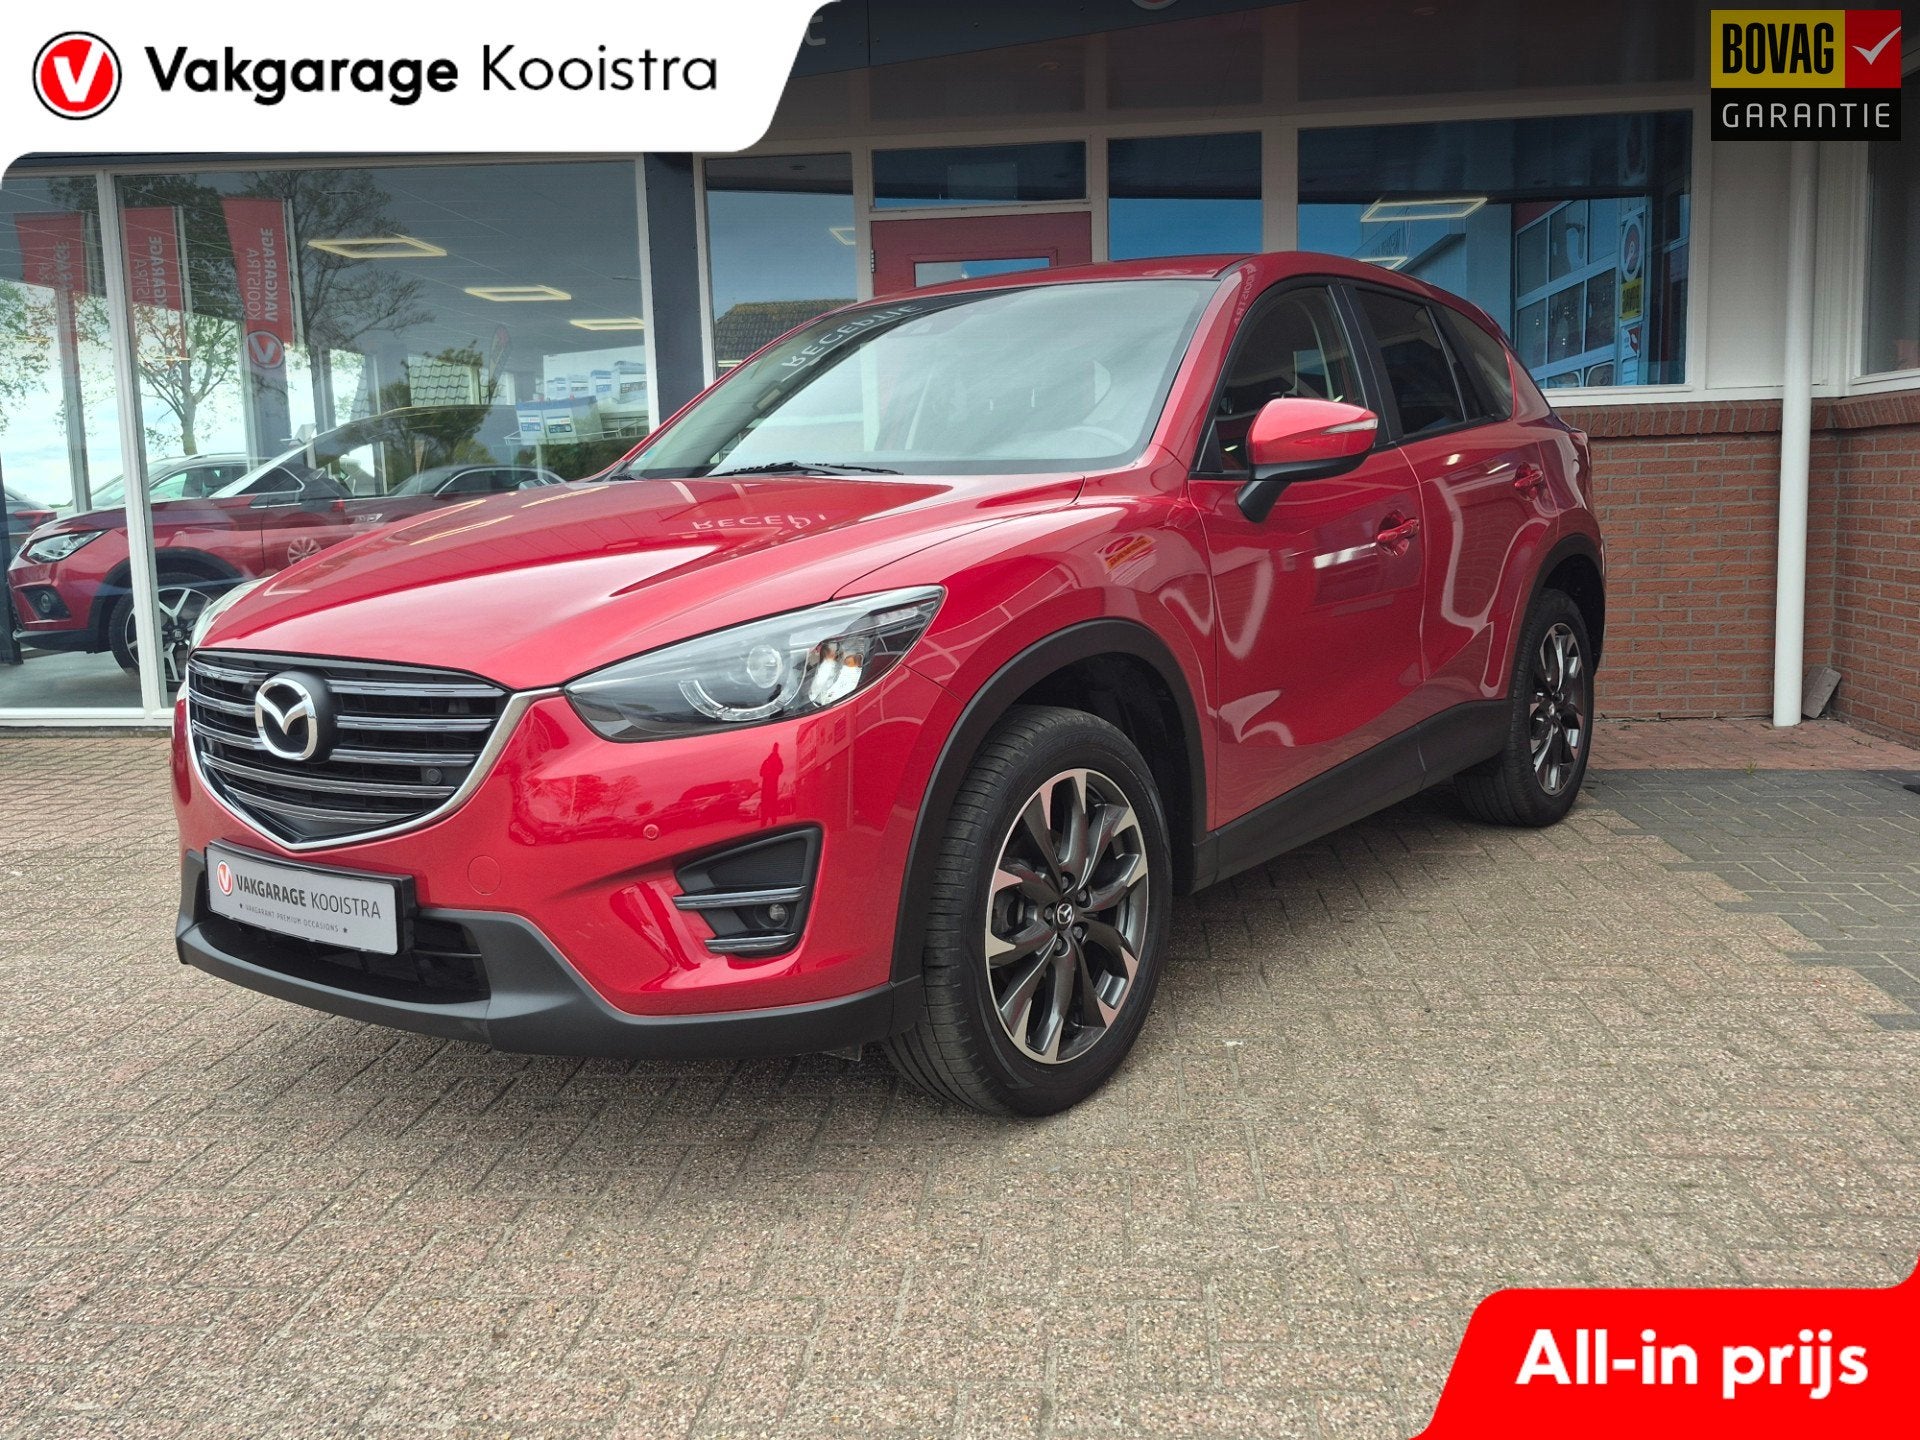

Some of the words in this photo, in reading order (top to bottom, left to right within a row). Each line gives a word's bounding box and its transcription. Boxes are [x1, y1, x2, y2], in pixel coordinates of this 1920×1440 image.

[236, 874, 307, 907] VAKGARAGE
[311, 892, 381, 919] KOOISTRA
[304, 919, 339, 933] OCCASIONS
